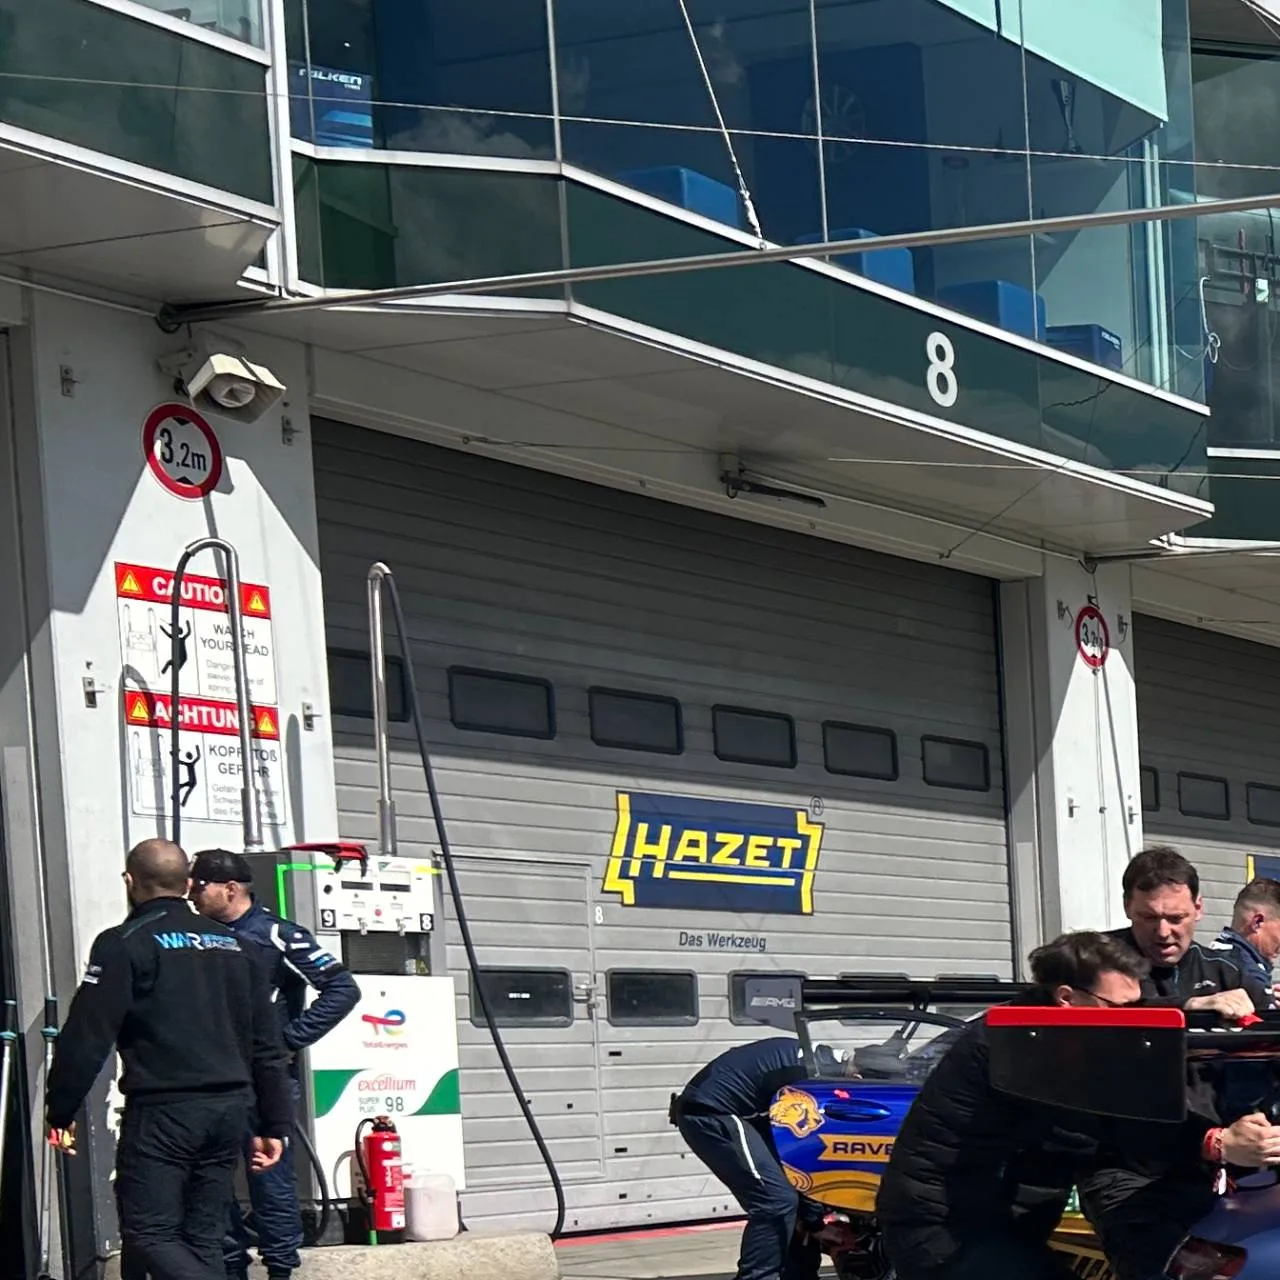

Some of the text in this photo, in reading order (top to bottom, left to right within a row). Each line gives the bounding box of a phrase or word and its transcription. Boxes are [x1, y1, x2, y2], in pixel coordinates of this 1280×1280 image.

[926, 331, 958, 408] 8
[160, 427, 207, 473] 3.2m
[152, 576, 225, 605] CAUTIO
[213, 623, 255, 640] WACH
[243, 644, 269, 657] EAD
[218, 762, 270, 778] GEFHR
[628, 822, 802, 879] HAZET
[321, 909, 433, 931] 9 8
[594, 906, 604, 924] 8
[679, 931, 767, 951] Das Werkzeug
[362, 1039, 408, 1049] TotalEnergies
[358, 1074, 416, 1092] excellium
[385, 1096, 405, 1112] 98
